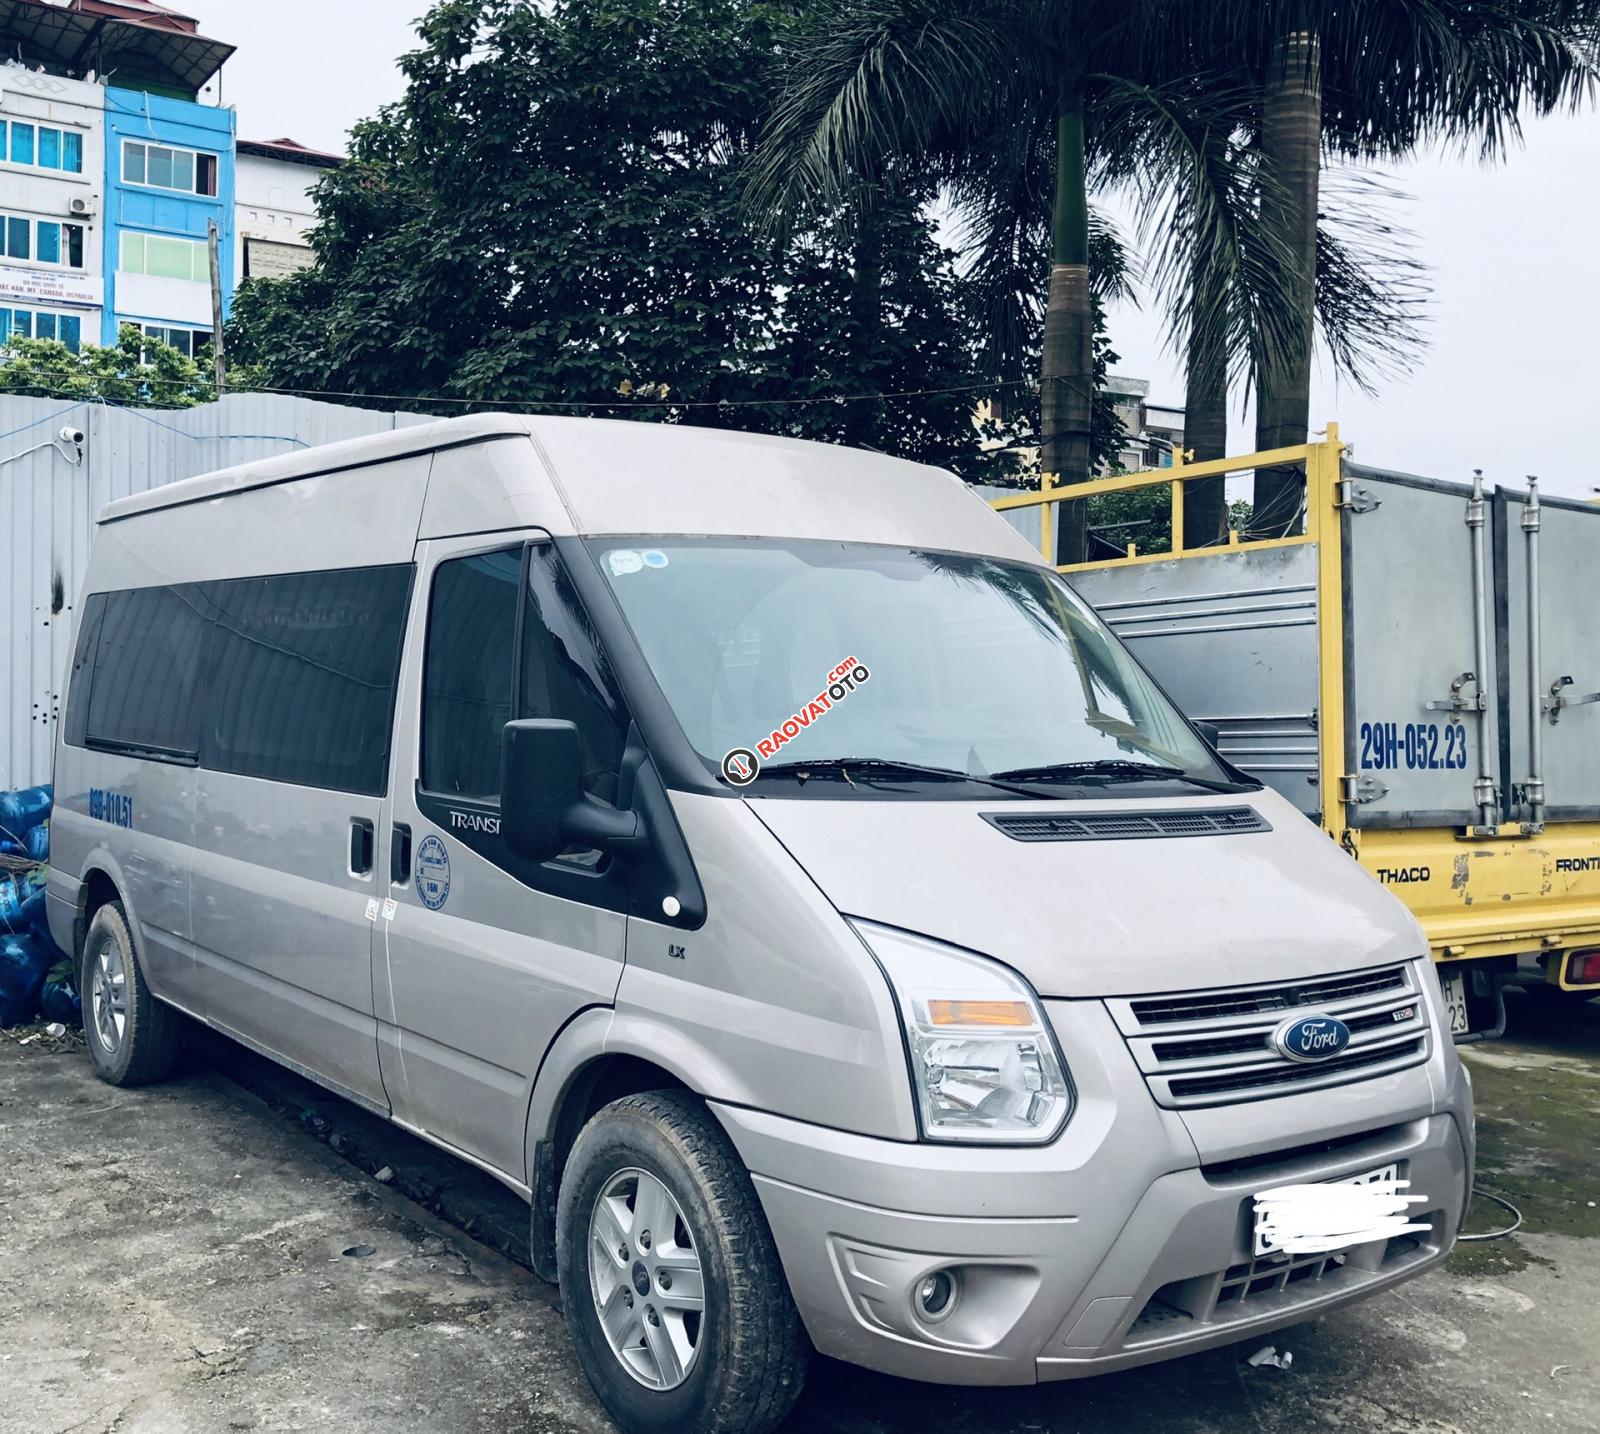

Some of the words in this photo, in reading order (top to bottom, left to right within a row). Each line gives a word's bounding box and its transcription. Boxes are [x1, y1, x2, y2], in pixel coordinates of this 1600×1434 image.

[1361, 722, 1467, 769] 29H-052.23
[1377, 867, 1430, 883] THACO
[669, 944, 685, 959] LX
[1301, 1022, 1339, 1051] Ford
